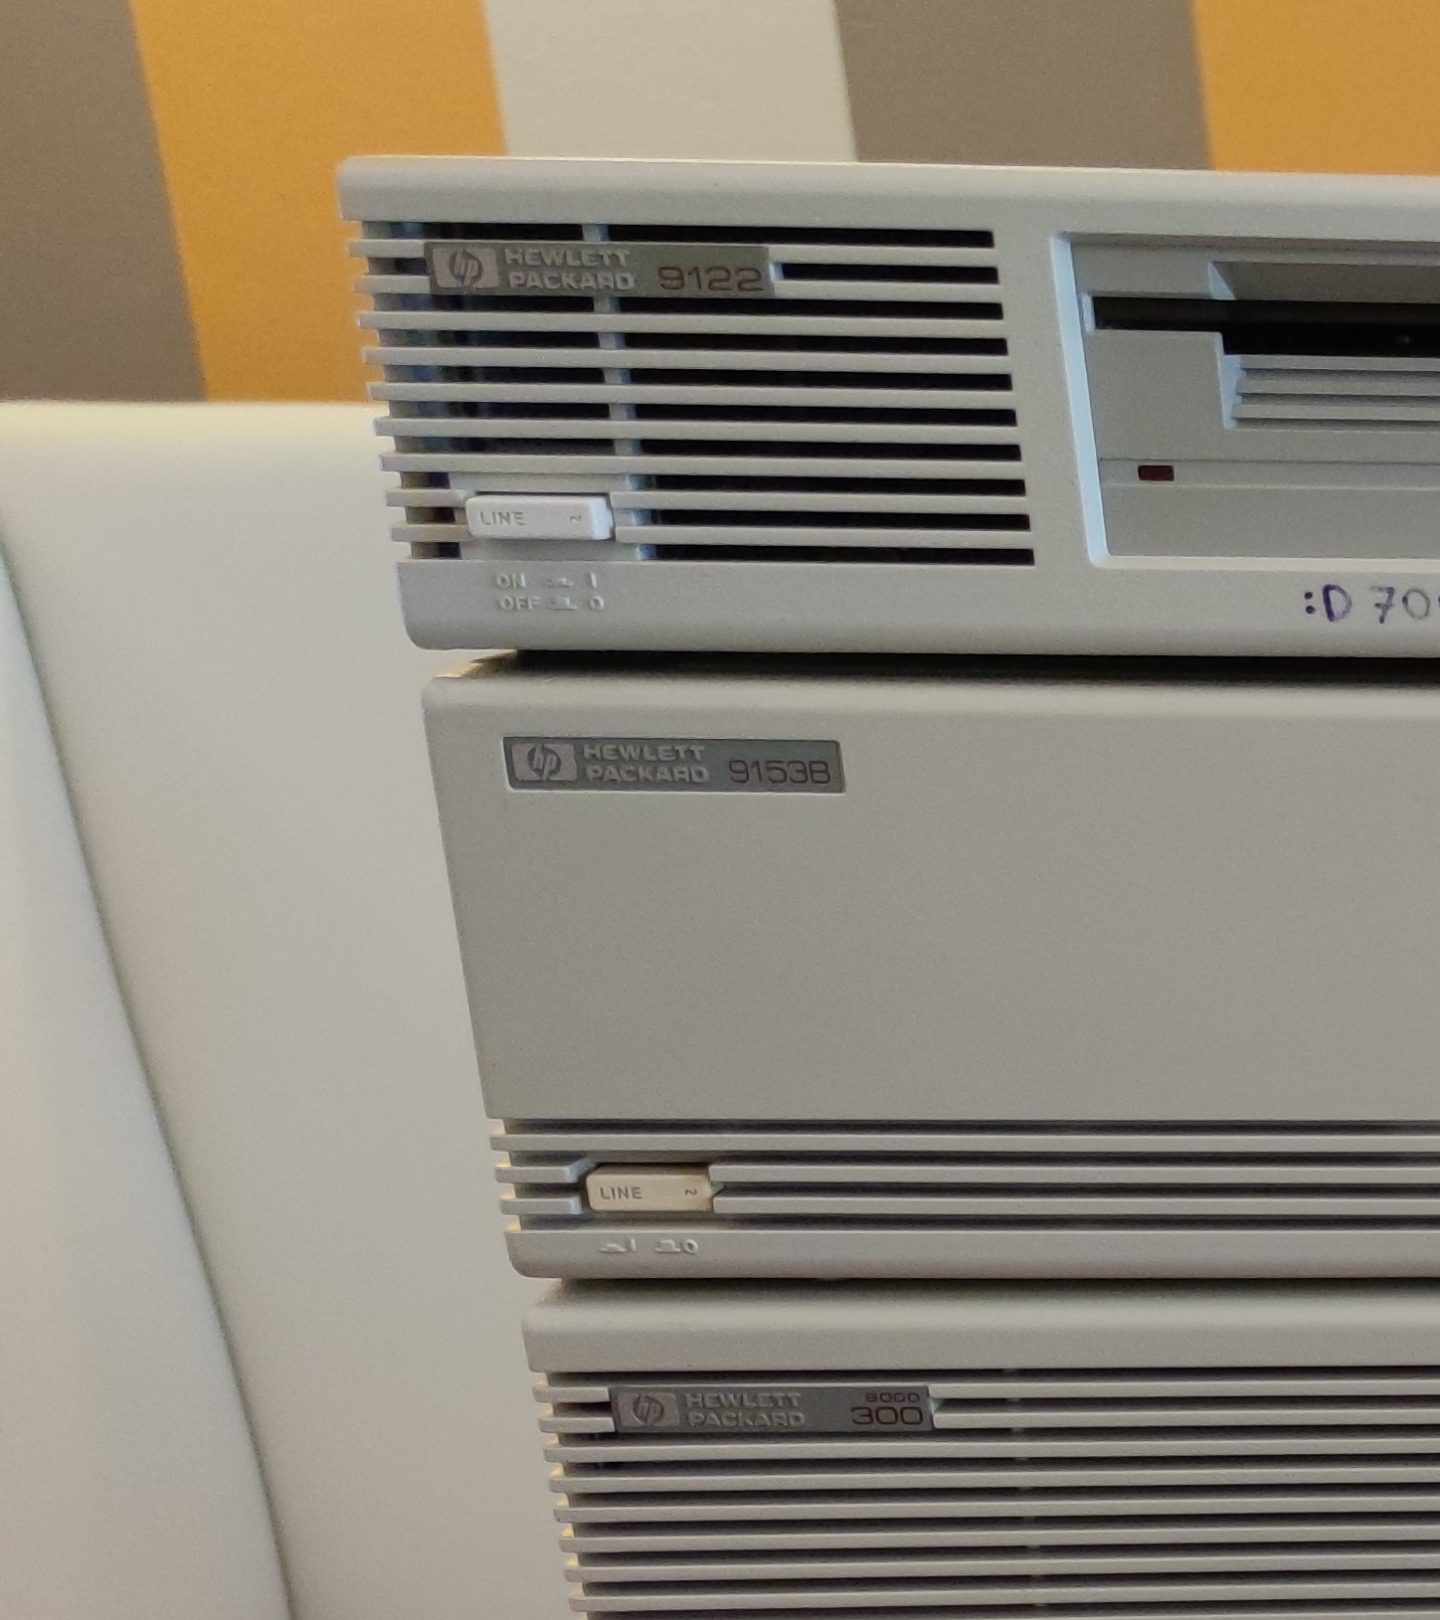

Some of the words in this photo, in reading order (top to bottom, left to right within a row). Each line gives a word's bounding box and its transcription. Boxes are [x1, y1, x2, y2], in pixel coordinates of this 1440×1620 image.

[504, 248, 630, 268] HEWLETT
[508, 271, 635, 291] PACKARD
[658, 267, 764, 291] 9122
[479, 510, 525, 527] LINE
[584, 744, 705, 762] HEWLETT
[586, 765, 709, 784] PACKARD
[728, 759, 832, 785] 9153B
[600, 1185, 642, 1200] LINE
[684, 1392, 801, 1409] HEWLETT
[688, 1411, 806, 1428] PACKARD
[850, 1406, 924, 1426] 300
